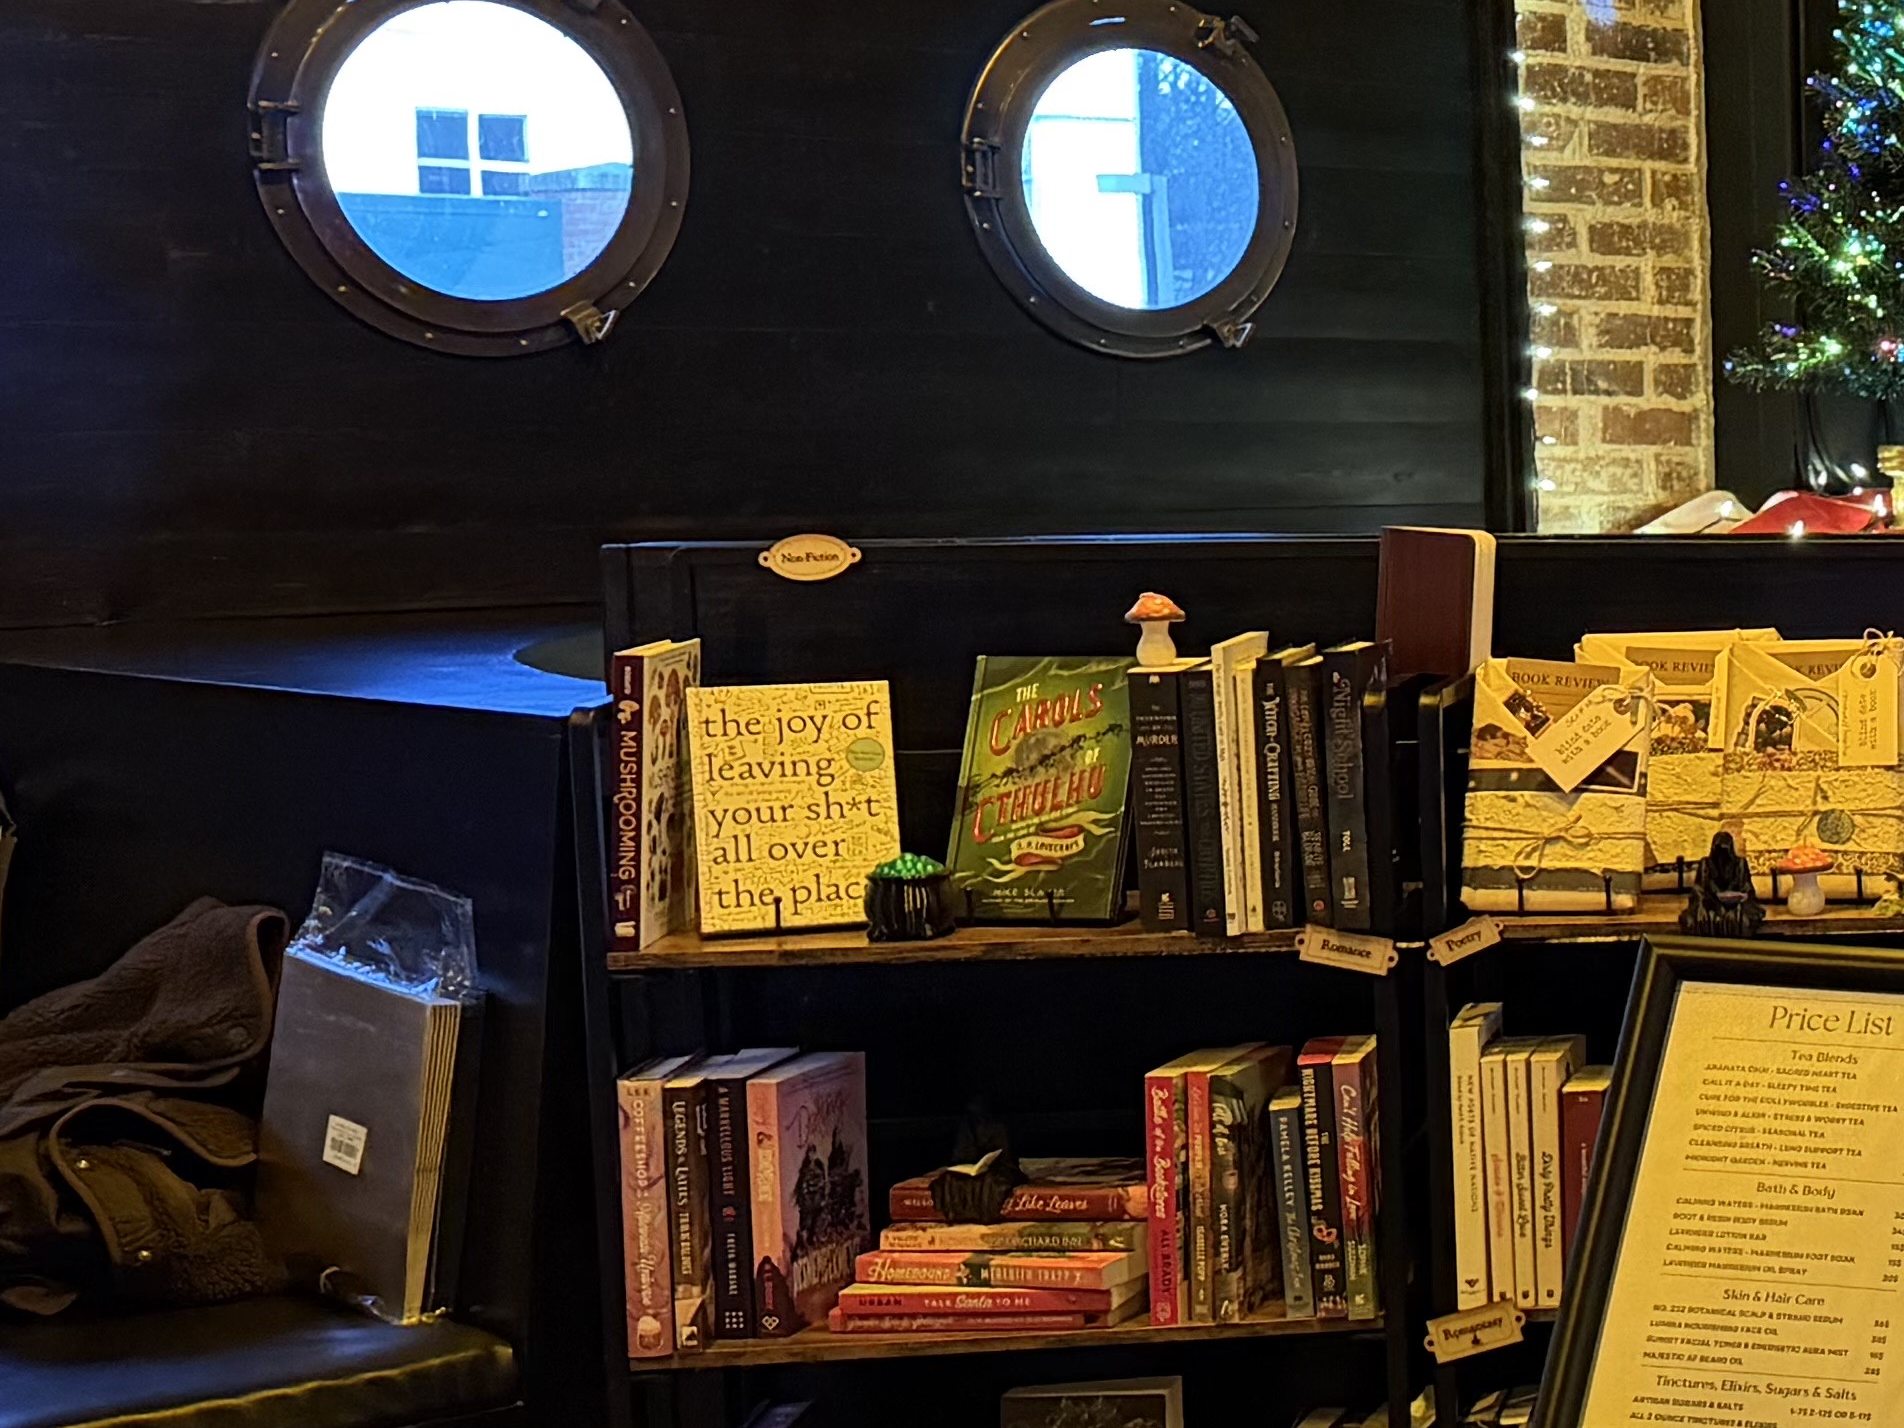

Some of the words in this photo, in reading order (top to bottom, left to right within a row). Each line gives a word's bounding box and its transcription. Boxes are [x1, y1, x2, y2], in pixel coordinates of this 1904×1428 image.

[1015, 683, 1040, 704] THE
[702, 708, 761, 738] the
[775, 708, 829, 745] joy
[841, 700, 881, 732] of
[989, 683, 1104, 757] CAROLS
[707, 753, 836, 788] leaving
[1085, 747, 1101, 765] OF
[619, 730, 639, 881] MUSHROOMING
[972, 762, 1106, 844] CTHULHU
[709, 805, 795, 839] your
[712, 833, 753, 867] all
[767, 836, 847, 862] over
[717, 878, 774, 910] the
[789, 873, 869, 915] plac
[1320, 939, 1372, 960] Romance
[1445, 929, 1483, 952] Poetry
[1768, 1004, 1842, 1035] Price
[1844, 1009, 1896, 1037] List
[1791, 1049, 1814, 1063] Tea
[1815, 1050, 1860, 1066] Blends
[1278, 1116, 1290, 1162] PAMELA
[1809, 1130, 1826, 1139] TEA
[1281, 1165, 1294, 1206] KELLEY
[1756, 1181, 1787, 1196] Bath
[1788, 1183, 1800, 1196] &
[1802, 1184, 1836, 1200] Body
[1722, 1287, 1751, 1302] Skin
[1752, 1290, 1763, 1303] &
[1764, 1291, 1793, 1305] Hair
[1794, 1293, 1826, 1307] Care
[1655, 1374, 1718, 1392] Tinctures,
[1720, 1378, 1763, 1395] Elixirs,
[1765, 1382, 1811, 1401] Sugars
[1812, 1385, 1823, 1399] &
[1824, 1386, 1858, 1402] Salts
